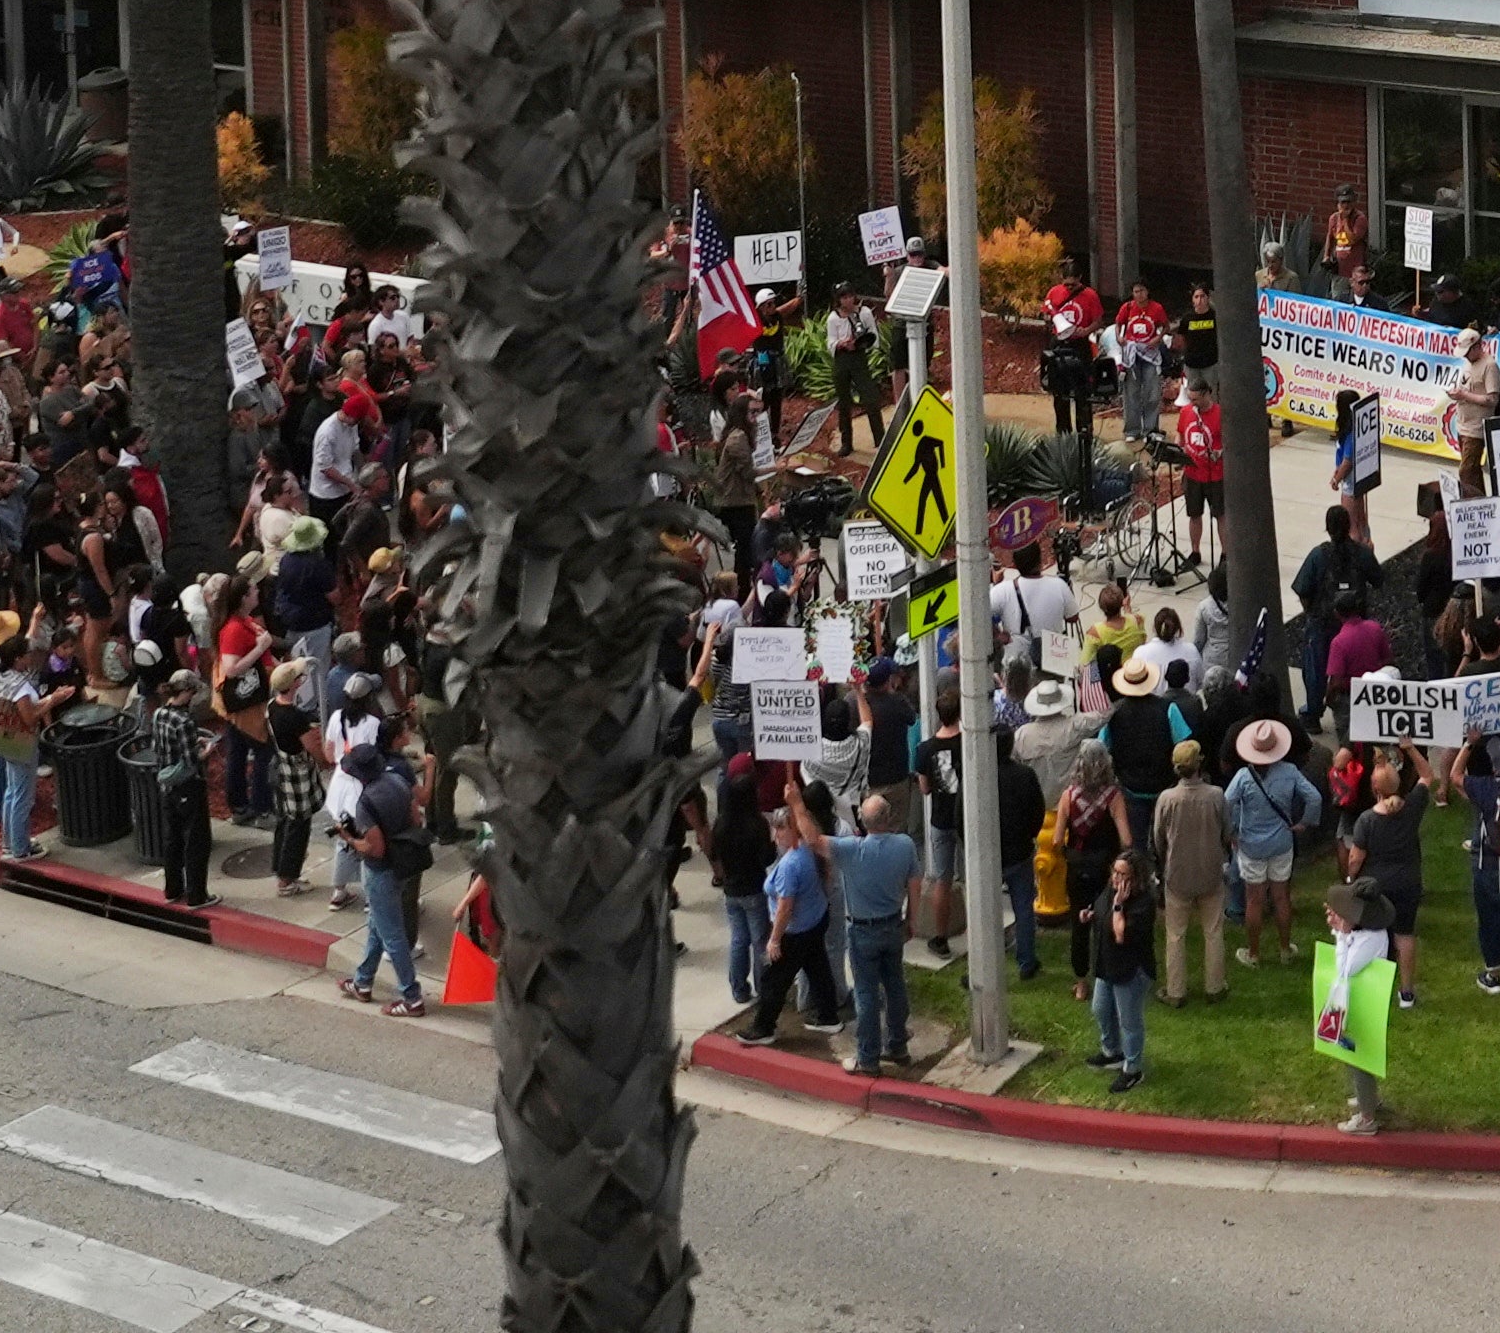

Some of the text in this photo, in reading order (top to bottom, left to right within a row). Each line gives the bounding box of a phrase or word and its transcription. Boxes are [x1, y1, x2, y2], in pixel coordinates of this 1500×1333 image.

[1408, 208, 1431, 224] STOP
[752, 235, 798, 265] HELP
[868, 235, 895, 249] FIGHT
[1409, 243, 1429, 263] NO
[1272, 296, 1334, 330] JUSTICIA
[1337, 311, 1356, 332] NO
[1360, 316, 1426, 350] NECESITA
[1429, 331, 1498, 358] MASRA!
[1260, 326, 1326, 359] USTICE
[1331, 341, 1396, 375] WEARS
[1401, 359, 1428, 383] NO
[1293, 364, 1325, 382] Comite
[1327, 371, 1337, 383] de
[1339, 374, 1365, 393] Accion
[1288, 381, 1331, 400] Committee
[1289, 399, 1329, 419] C.A.S.A.
[1386, 406, 1410, 423] Social
[1411, 411, 1438, 426] Action
[1356, 406, 1377, 438] ICE
[1387, 421, 1435, 443] 746-6264
[1457, 510, 1496, 523] ARE THE
[1467, 522, 1486, 530] REAL
[849, 542, 899, 555] OBRERA
[1463, 542, 1492, 558] NOT
[866, 560, 886, 572] NO
[858, 573, 888, 586] TIEN
[757, 688, 814, 696] THE PEOPLE
[1353, 684, 1458, 711] ABOLISH
[757, 695, 815, 708] UNITED
[762, 725, 813, 733] IMMIGRANT
[1381, 710, 1431, 737] ICE
[758, 734, 818, 744] FAMILIES!
